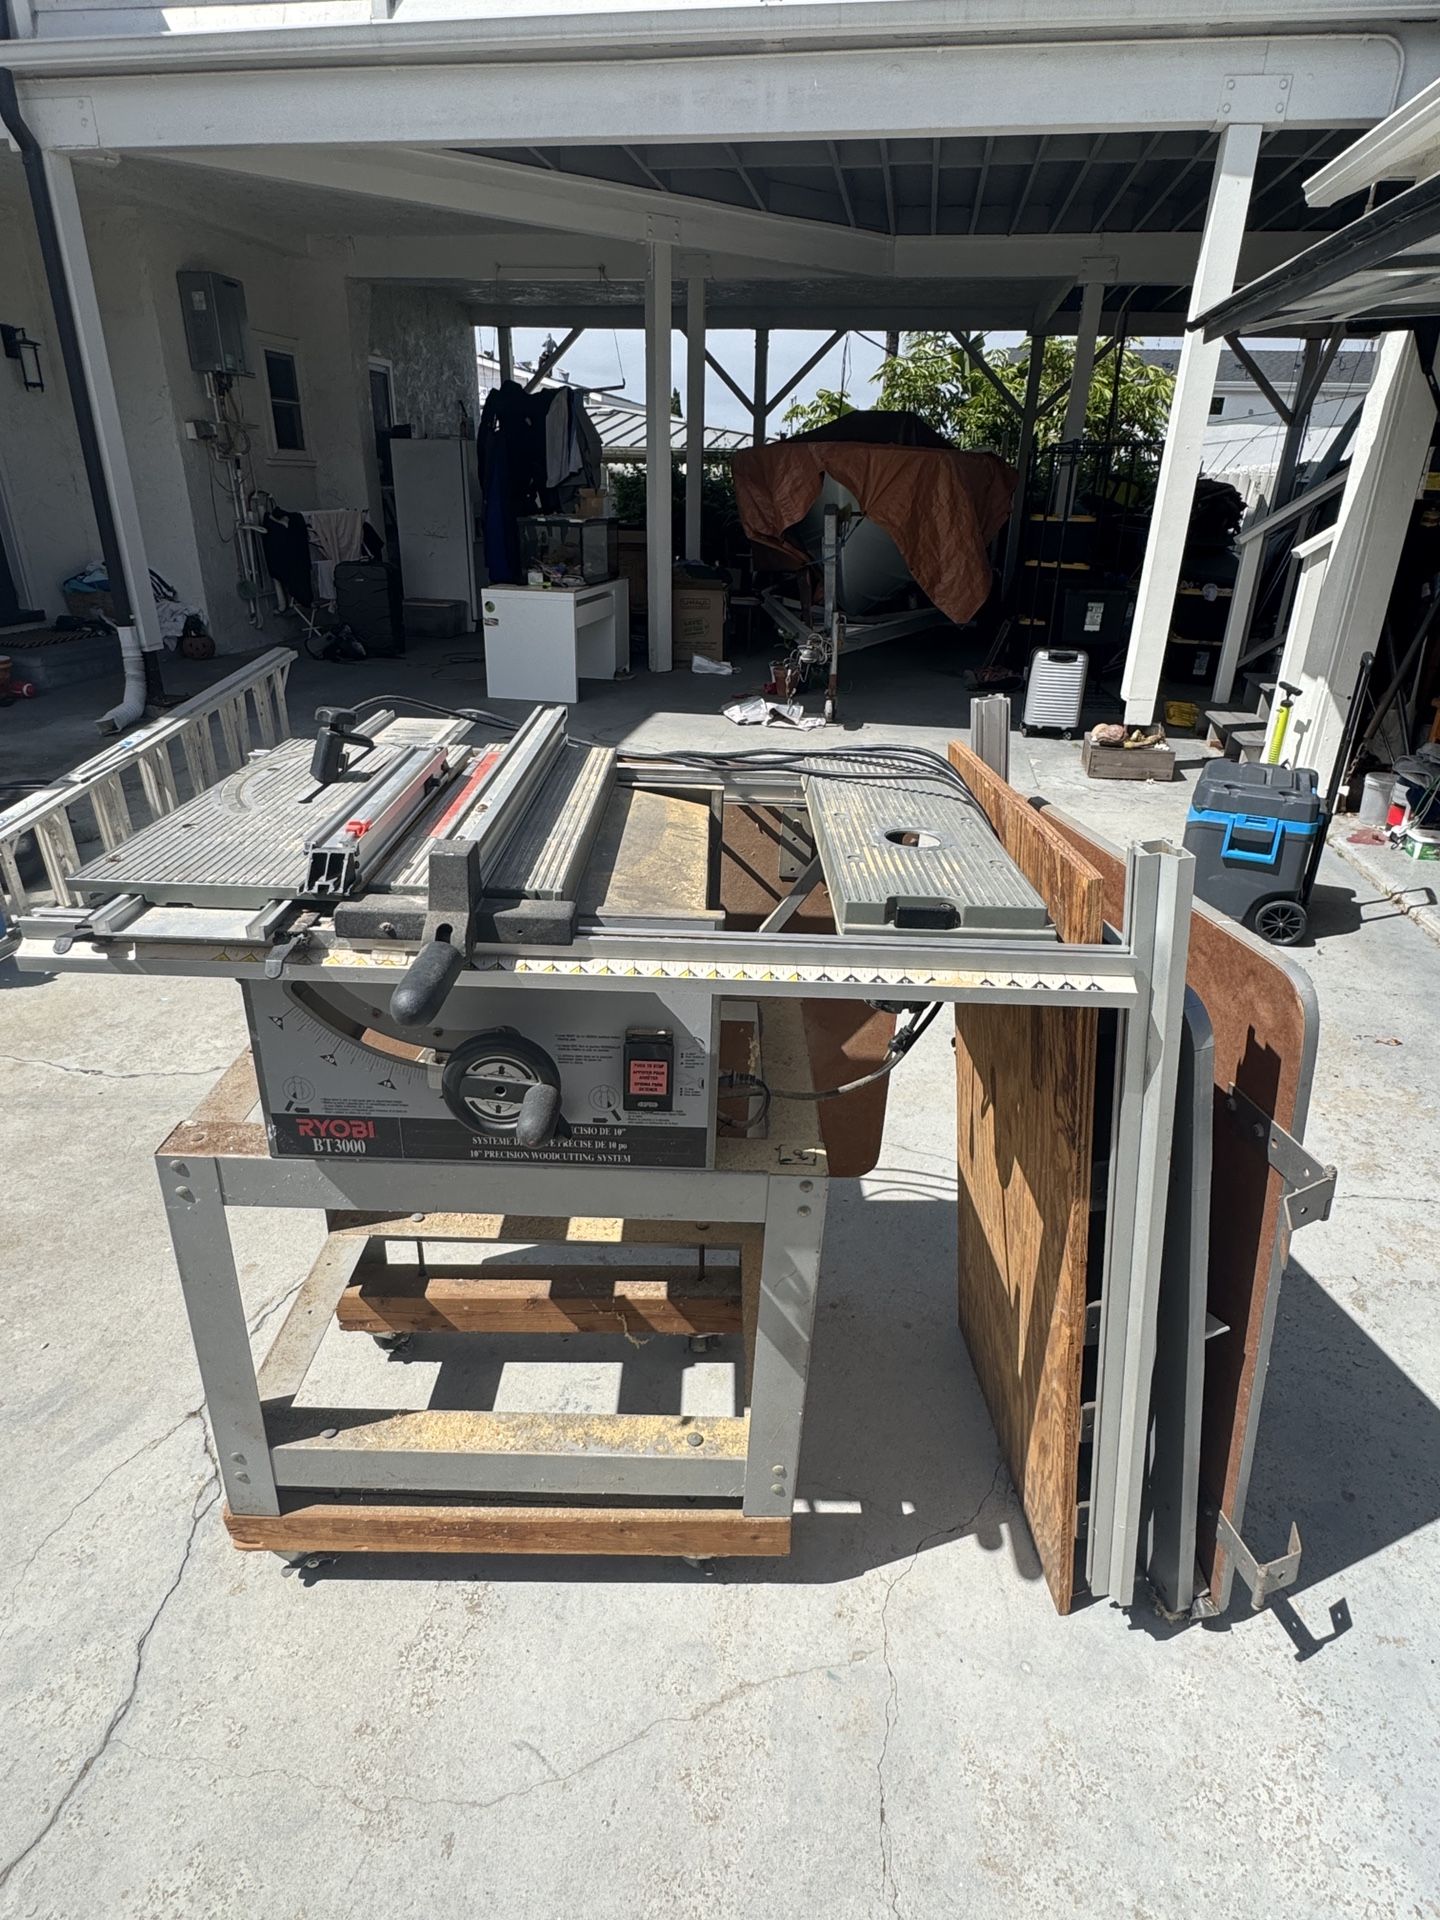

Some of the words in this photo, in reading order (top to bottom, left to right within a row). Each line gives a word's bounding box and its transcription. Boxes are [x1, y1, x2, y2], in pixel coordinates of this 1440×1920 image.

[296, 1118, 377, 1138] RYOBI
[599, 1127, 611, 1136] DE
[312, 1138, 367, 1154] BT3000
[594, 1140, 607, 1149] DE
[608, 1141, 617, 1149] 10
[484, 1150, 530, 1160] PRECISION
[530, 1152, 595, 1162] WOODCUTTING
[596, 1154, 631, 1163] SYSTEM
